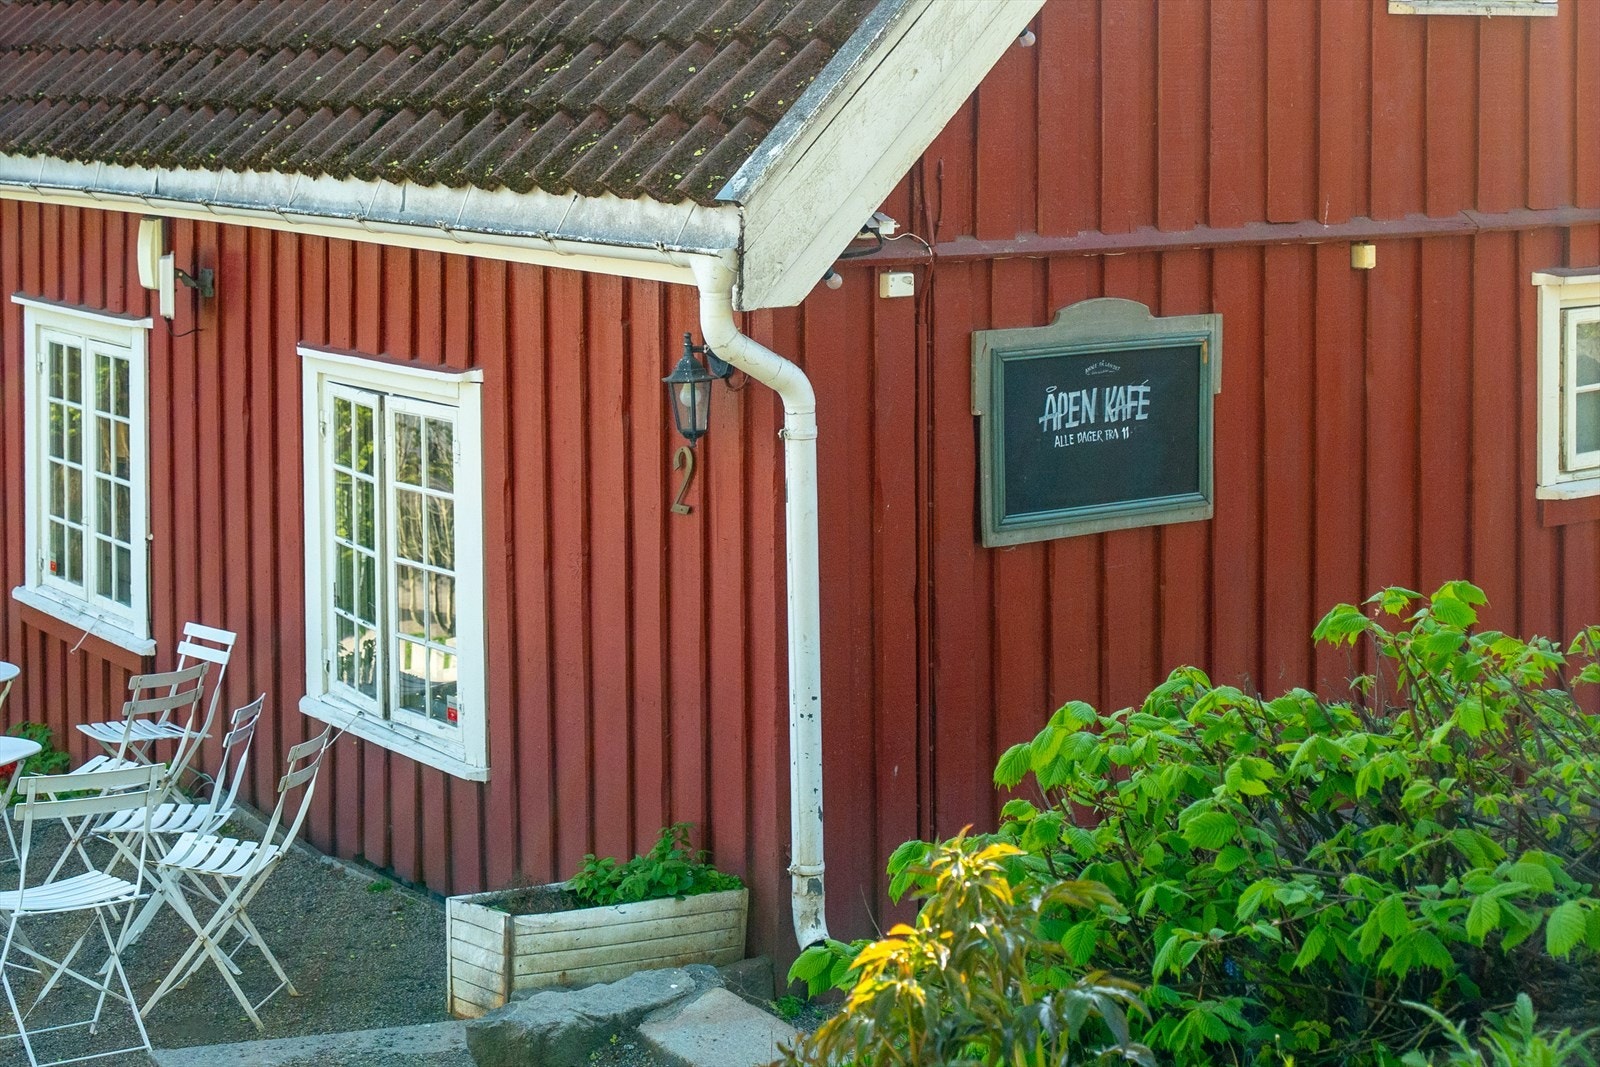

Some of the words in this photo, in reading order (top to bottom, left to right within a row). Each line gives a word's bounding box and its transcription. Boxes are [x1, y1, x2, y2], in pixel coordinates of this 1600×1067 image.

[1039, 385, 1098, 432] ÅPEN
[1104, 379, 1151, 423] KAFÉ
[1054, 433, 1075, 448] ALLE
[1077, 430, 1104, 443] DAGER
[1105, 428, 1119, 441] FRA
[670, 446, 692, 514] 2
